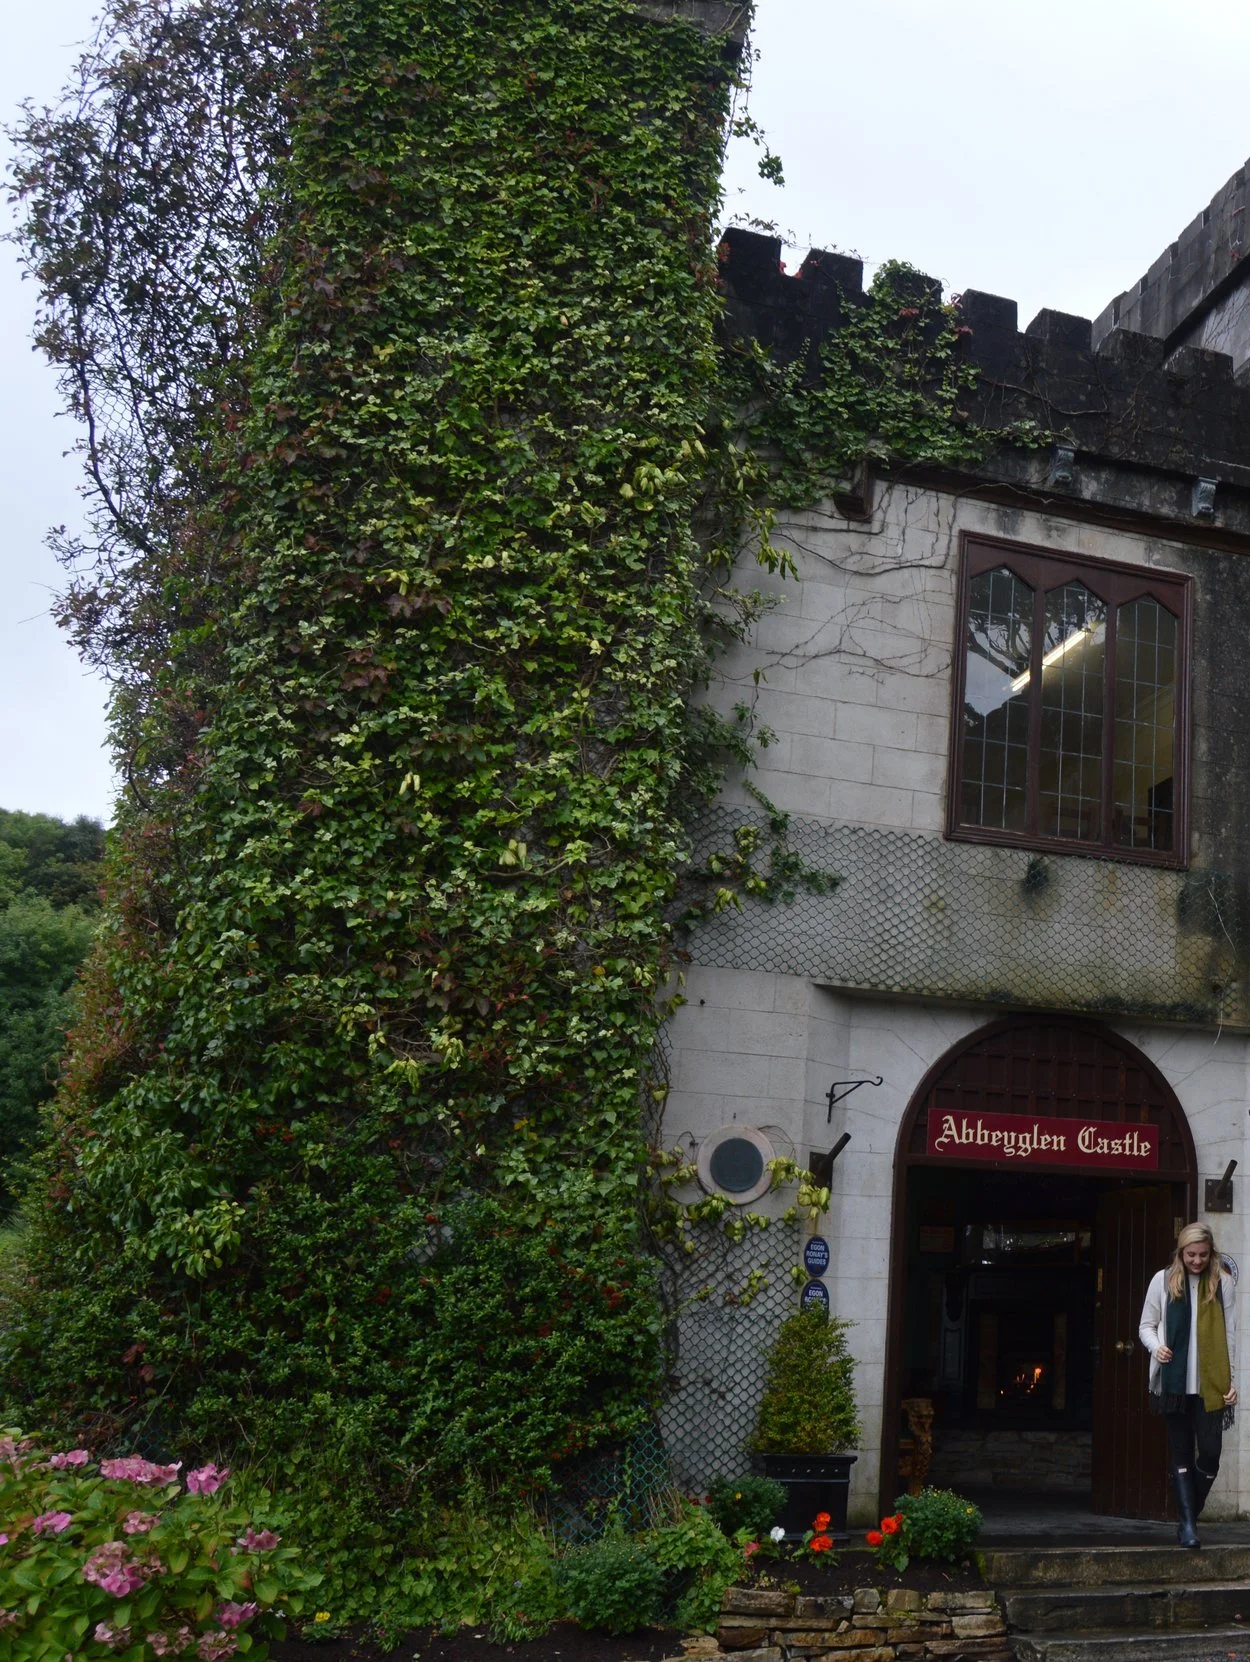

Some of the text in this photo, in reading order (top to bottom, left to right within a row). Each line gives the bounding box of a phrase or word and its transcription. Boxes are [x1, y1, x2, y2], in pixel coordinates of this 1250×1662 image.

[935, 1115, 1151, 1157] Abbeyglen Castle
[808, 1289, 823, 1297] EGON
